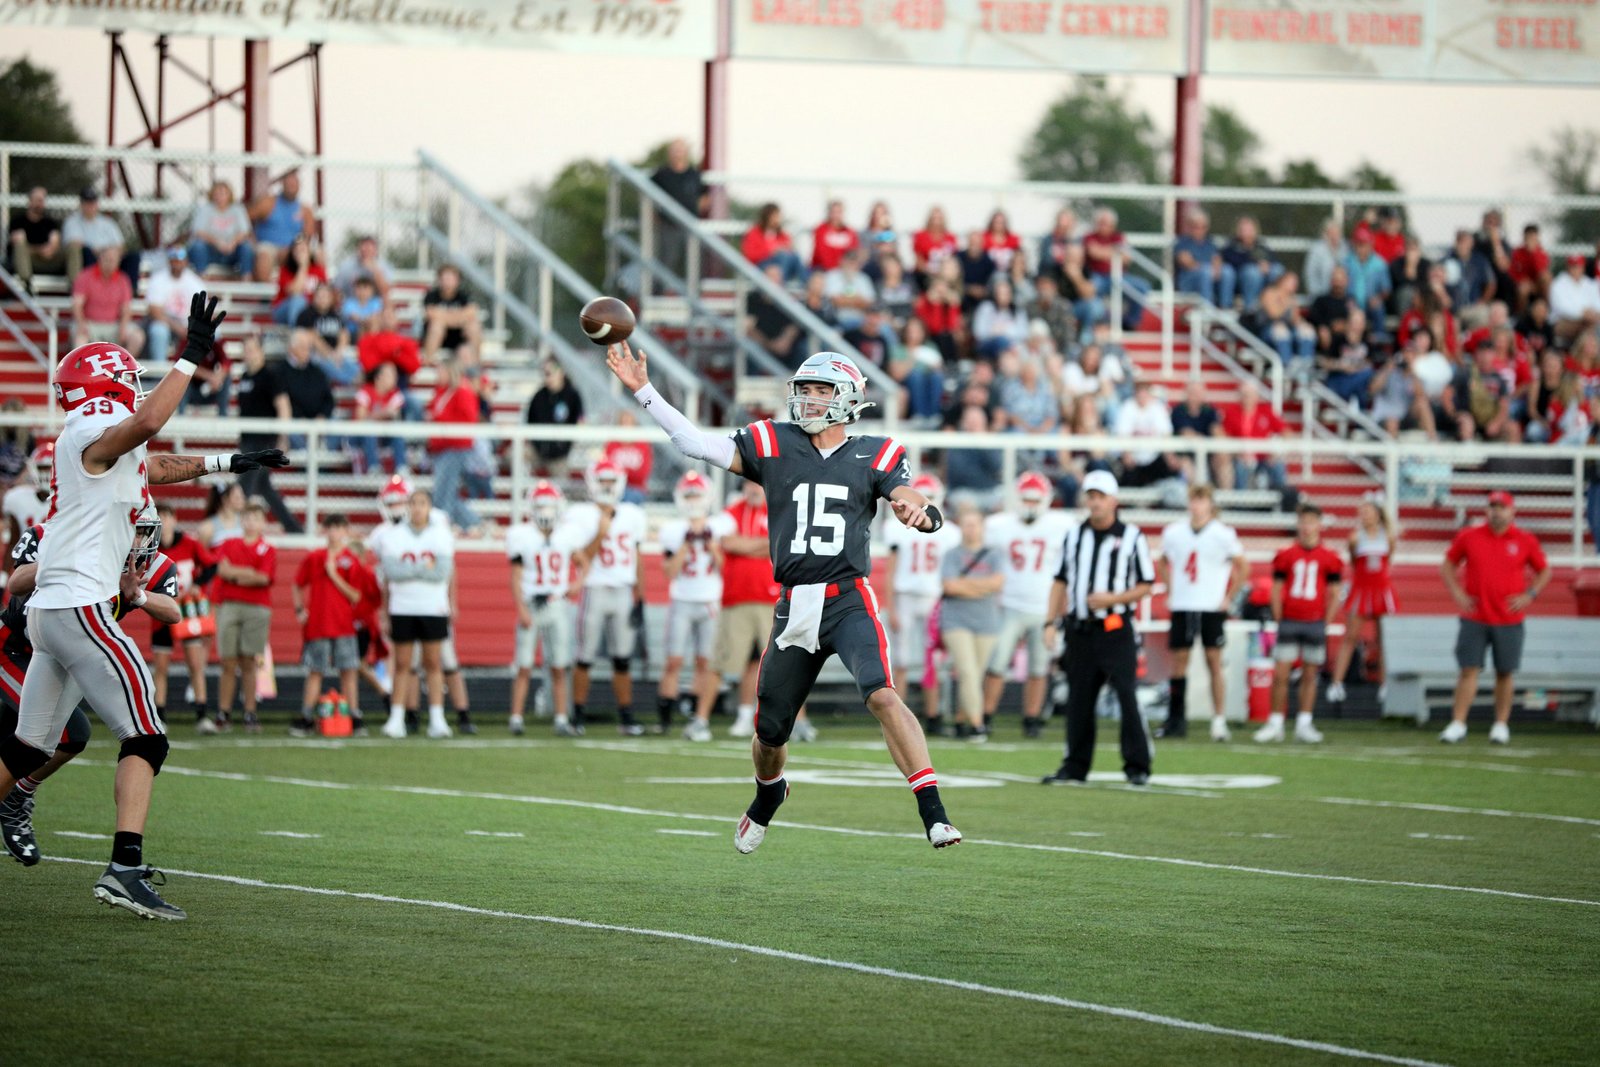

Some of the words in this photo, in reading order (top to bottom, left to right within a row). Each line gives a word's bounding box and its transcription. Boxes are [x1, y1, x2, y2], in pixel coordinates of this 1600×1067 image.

[259, 0, 296, 29] of
[591, 4, 685, 38] 1997
[752, 0, 863, 28] EAGLES
[979, 0, 1051, 34] TURF
[1060, 4, 1169, 38] CENTER
[1211, 8, 1339, 44] FUNERAL
[1347, 12, 1423, 47] HOME
[1495, 17, 1583, 49] STEEL
[85, 351, 128, 377] H
[82, 400, 113, 416] 39
[789, 482, 849, 556] 15
[600, 532, 632, 567] 65
[910, 540, 939, 573] 16
[1009, 537, 1047, 572] 67
[534, 551, 562, 585] 19
[1184, 551, 1198, 584] 4
[1290, 558, 1319, 600] 11
